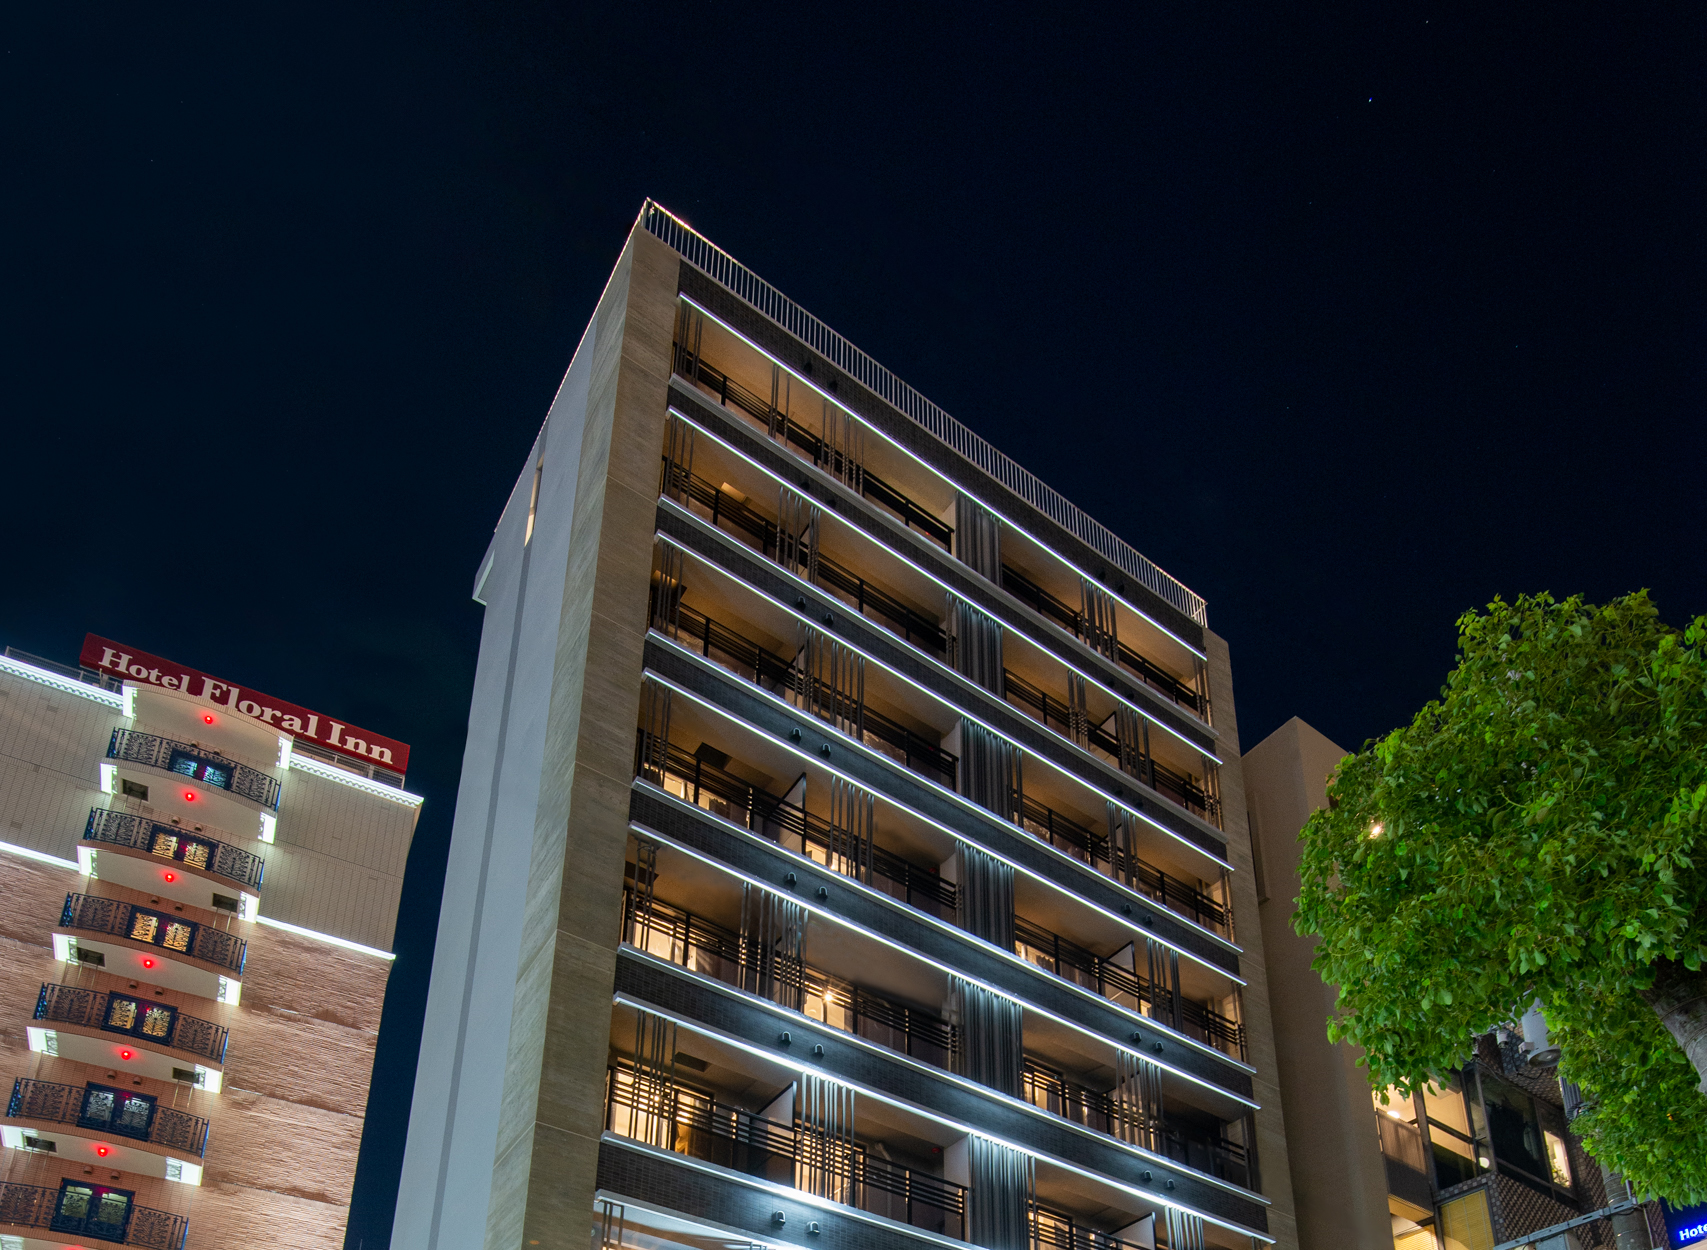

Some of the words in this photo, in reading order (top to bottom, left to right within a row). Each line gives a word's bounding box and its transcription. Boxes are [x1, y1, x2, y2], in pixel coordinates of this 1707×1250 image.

[98, 647, 191, 694] Hotel
[197, 677, 320, 738] Floral
[326, 721, 393, 765] Inn
